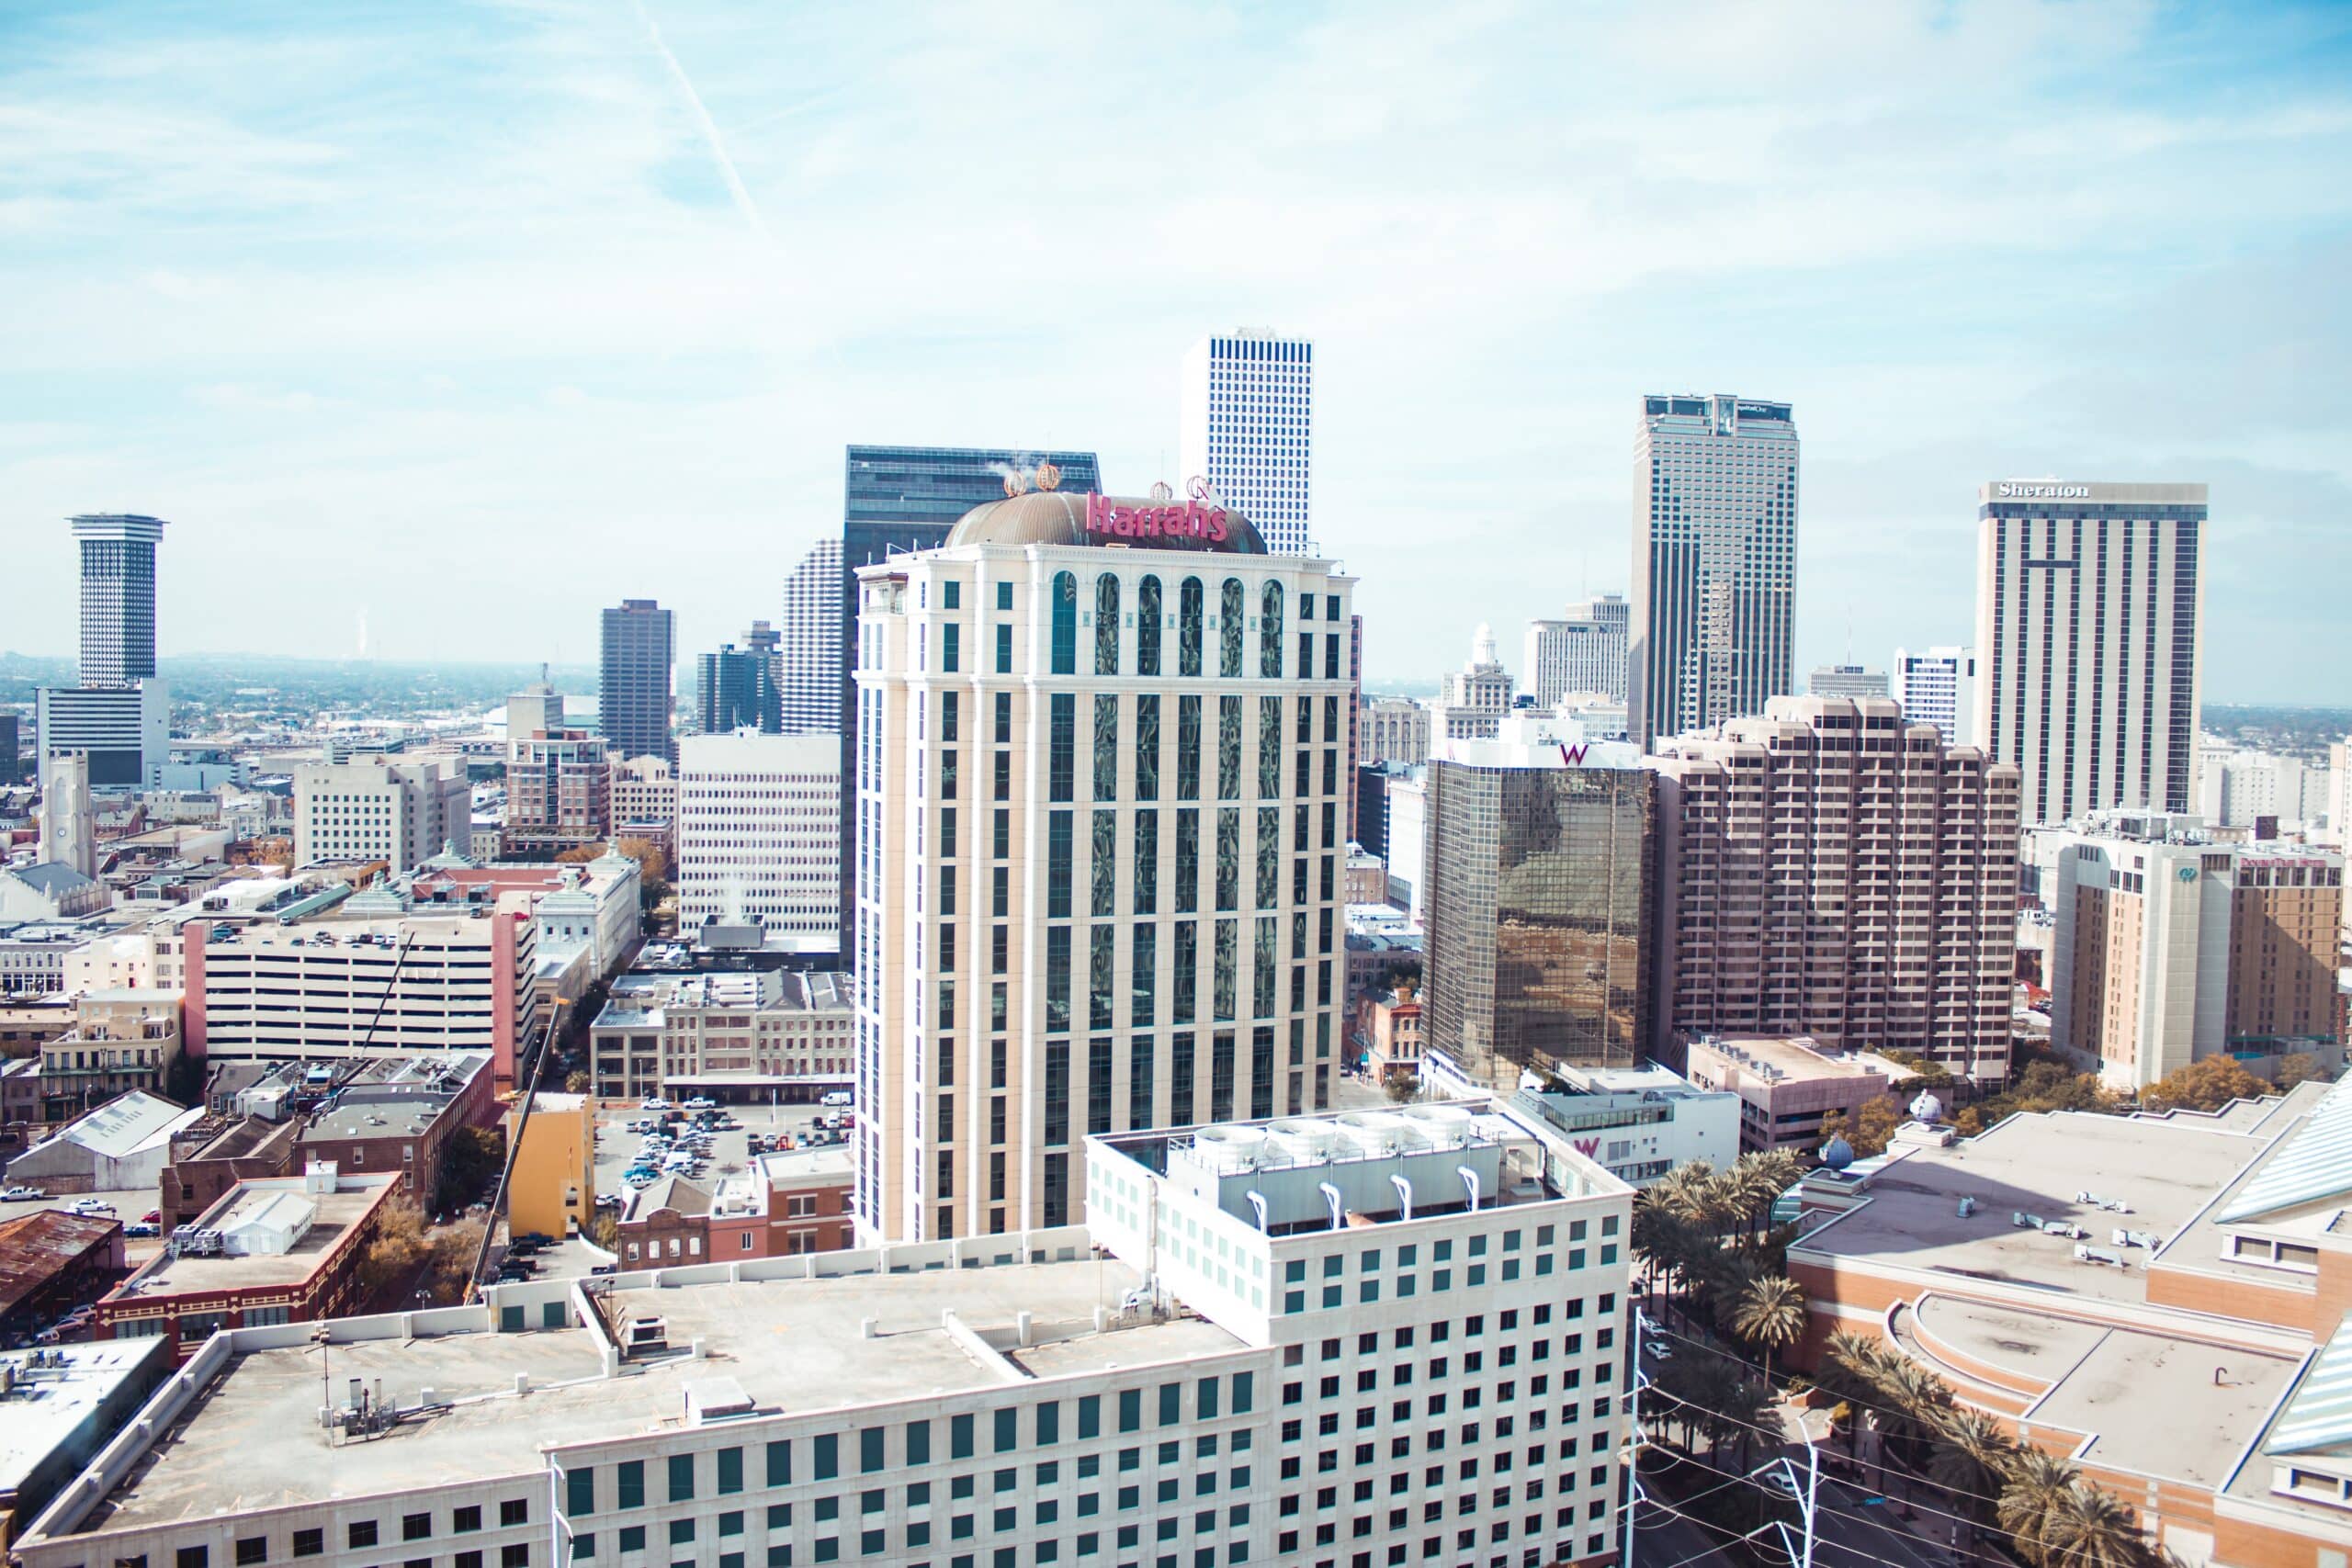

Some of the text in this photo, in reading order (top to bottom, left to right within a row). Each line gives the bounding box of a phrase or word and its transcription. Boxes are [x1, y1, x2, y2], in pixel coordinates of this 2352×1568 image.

[1998, 483, 2089, 498] Sheraton
[1560, 743, 1589, 767] W
[1574, 1136, 1601, 1160] W
